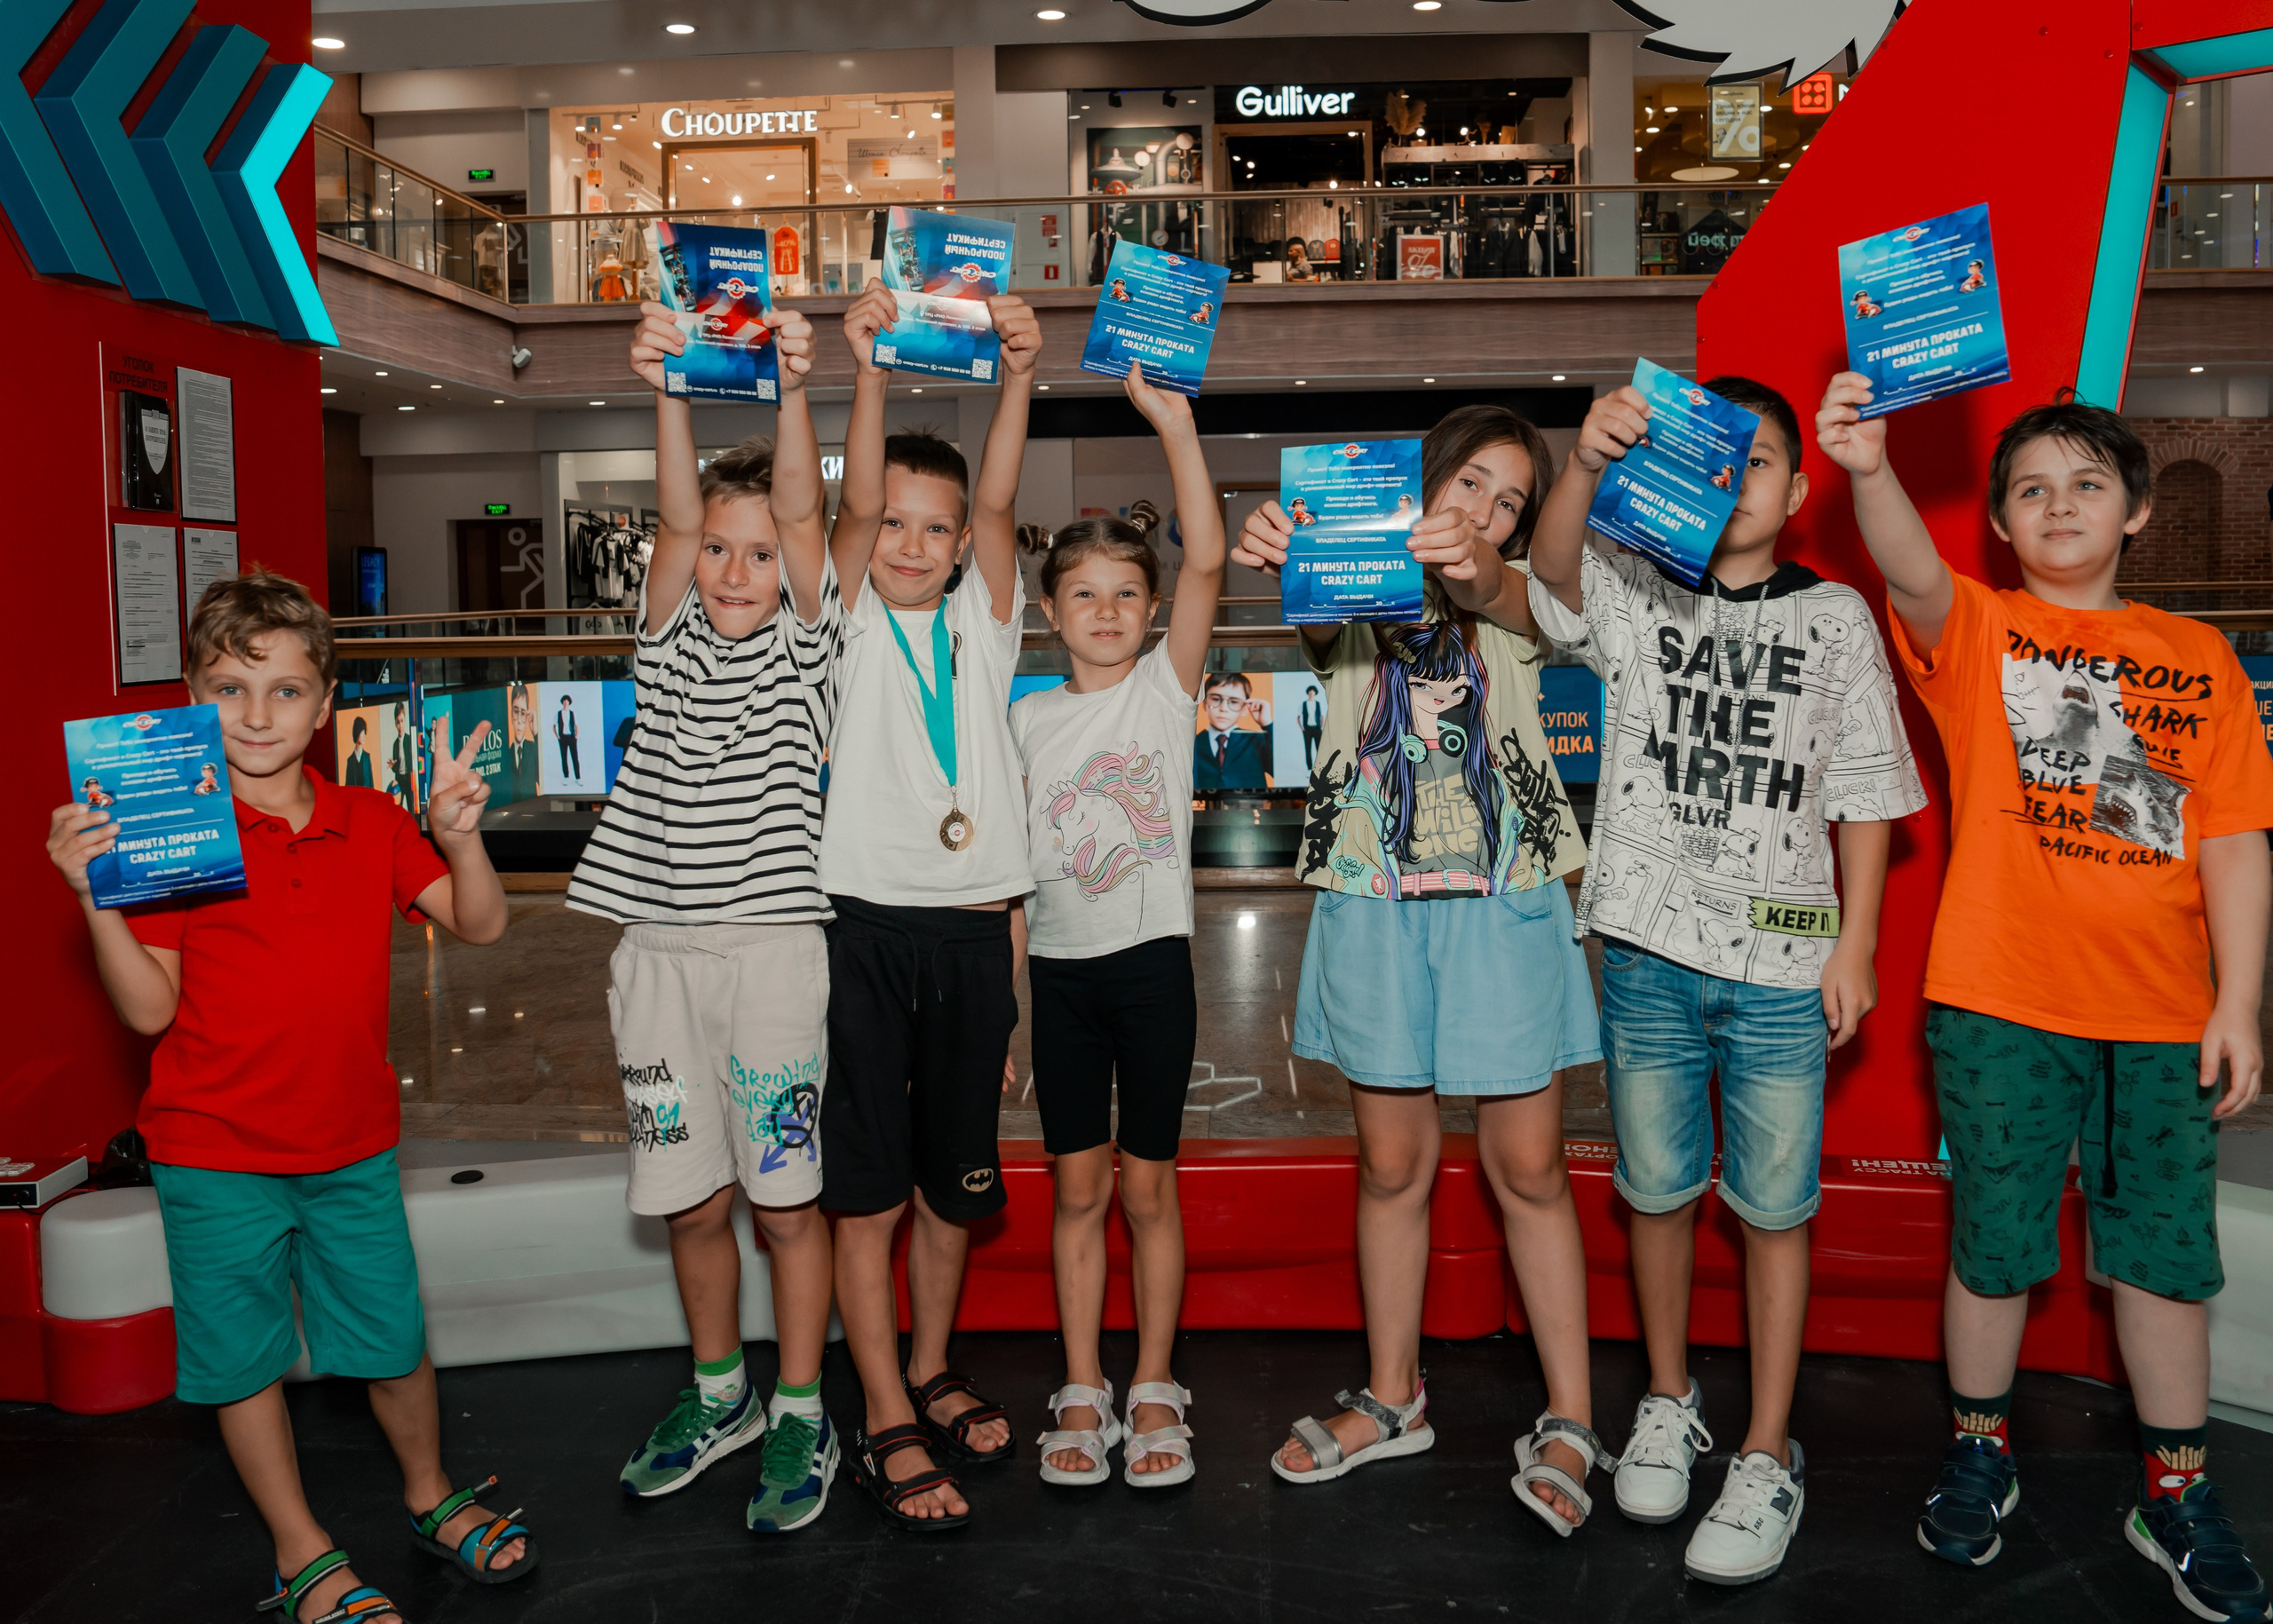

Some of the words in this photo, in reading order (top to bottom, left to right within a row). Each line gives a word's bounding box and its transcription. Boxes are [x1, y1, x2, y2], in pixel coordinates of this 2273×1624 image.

[1236, 86, 1356, 117] Gulliver
[661, 107, 819, 138] CHOUPETTE
[944, 244, 1005, 260] ПОДАРОЧНЫЙ
[946, 233, 1006, 249] СЕРТИФИКАТ
[709, 247, 763, 260] СЕРТИФИКАТ
[709, 258, 764, 273] ПОДАРОЧНЫЙ
[1105, 324, 1116, 334] 21
[1116, 327, 1154, 344] МИНУТА
[1154, 337, 1195, 354] ПРОКАТА
[1121, 338, 1150, 353] CRAZY
[1150, 345, 1174, 359] CART
[1866, 349, 1880, 362] 21
[1881, 336, 1928, 359] МИНУТА
[1930, 321, 1983, 345] ПРОКАТА
[123, 355, 154, 373] УГОЛОК
[1891, 350, 1928, 369] CRAZY
[1929, 342, 1960, 359] CART
[109, 370, 168, 392] ПОТРЕБИТЕЛЯ
[1616, 474, 1629, 488] 21
[1627, 479, 1666, 508] МИНУТА
[1664, 499, 1707, 530] ПРОКАТА
[1628, 496, 1659, 519] CRAZY
[1657, 511, 1683, 533] CART
[361, 557, 380, 567] LEGACY
[1298, 562, 1310, 572] 21
[1312, 561, 1355, 572] МИНУТА
[1358, 560, 1405, 571] ПРОКАТА
[1321, 574, 1353, 585] CRAZY
[1356, 574, 1382, 584] CART
[1659, 626, 1806, 696] SAVE
[1539, 712, 1588, 728] КУПОК
[1665, 683, 1776, 749] THE
[2109, 701, 2208, 740] SHARK
[1545, 735, 1595, 756] ИДКА
[2021, 736, 2091, 772] DEEP
[1826, 779, 1878, 802] CLICK!
[2021, 769, 2086, 796] BLUE
[1668, 803, 1730, 829] GLVR
[2024, 795, 2088, 833] FEAR
[116, 836, 166, 852] МИНУТА
[167, 828, 219, 846] ПРОКАТА
[2039, 835, 2111, 865] PACIFIC
[2119, 848, 2174, 867] OCEAN
[129, 850, 166, 864] CRAZY
[168, 845, 197, 859] CART
[1691, 889, 1738, 911] RETURNS
[1765, 907, 1817, 931] KEEP
